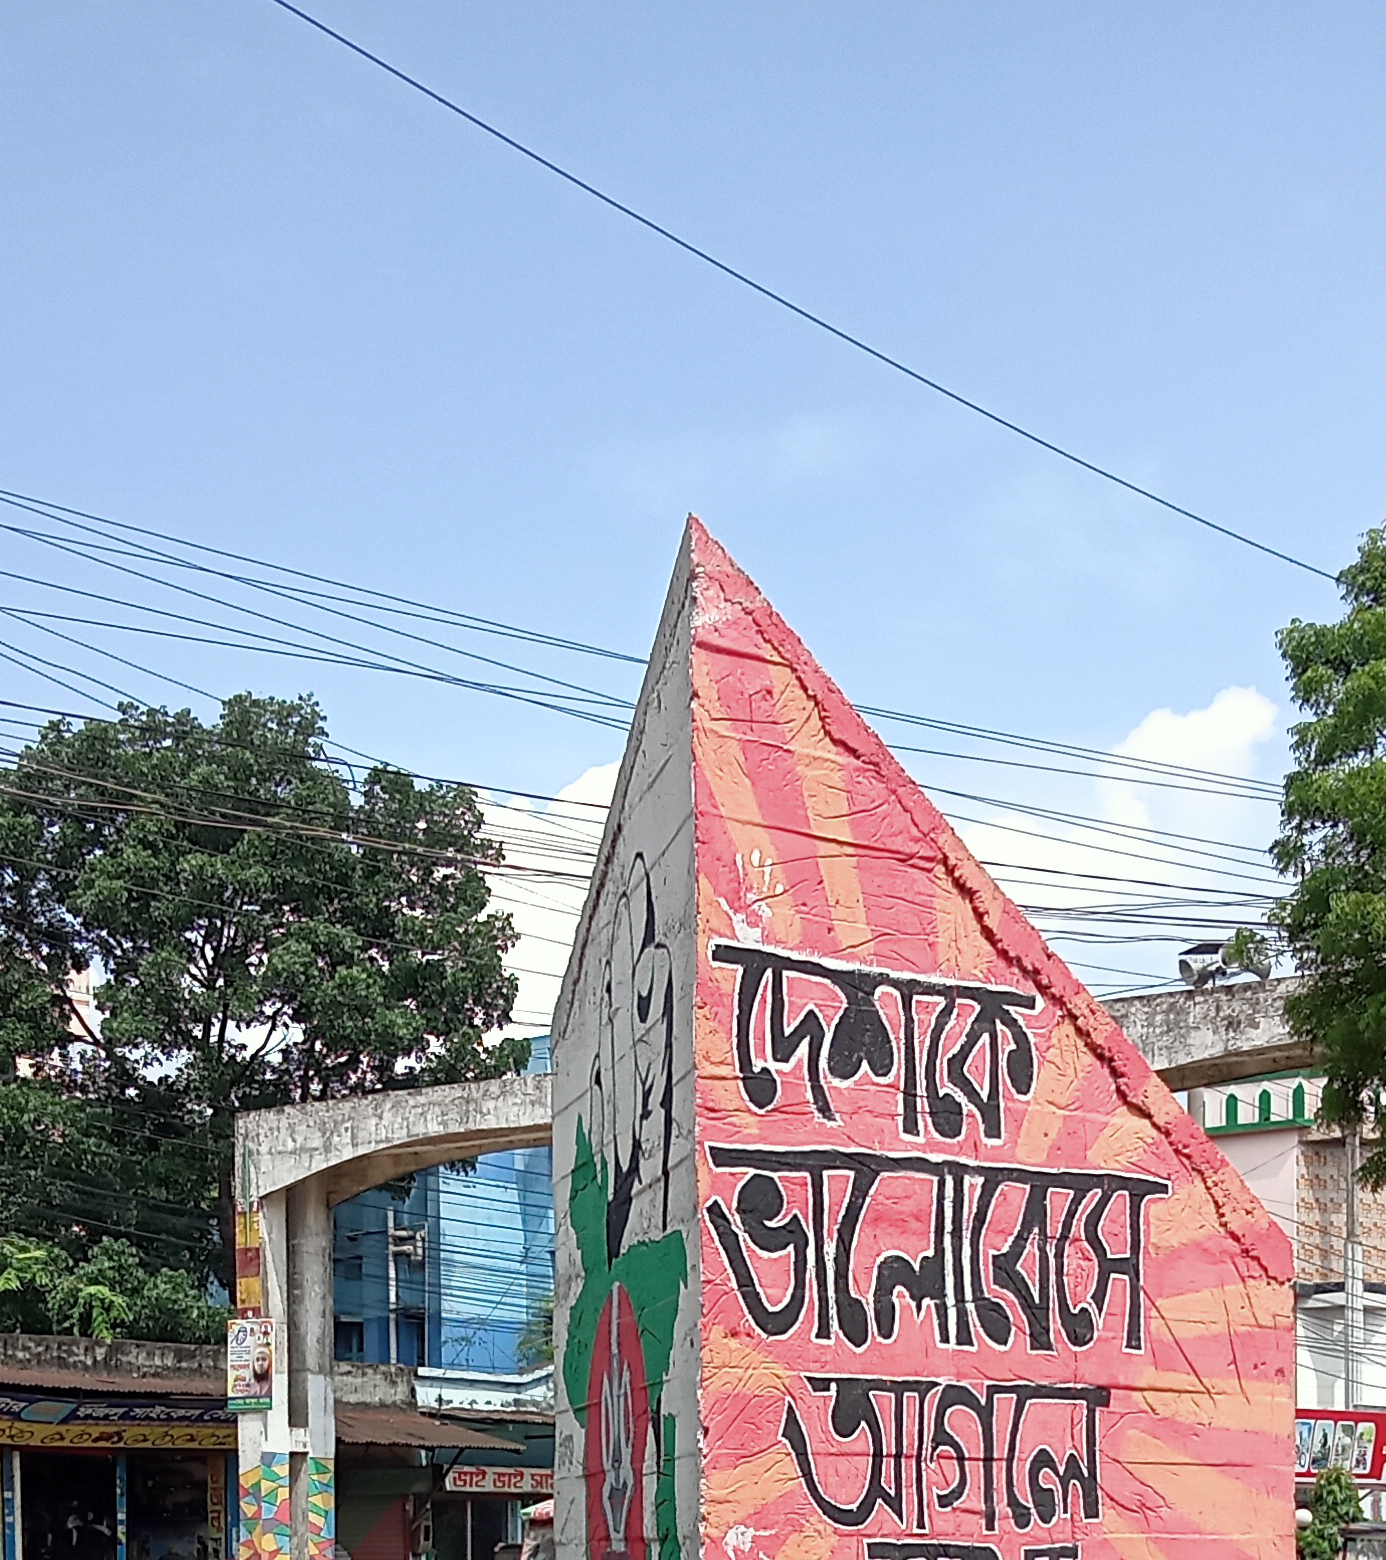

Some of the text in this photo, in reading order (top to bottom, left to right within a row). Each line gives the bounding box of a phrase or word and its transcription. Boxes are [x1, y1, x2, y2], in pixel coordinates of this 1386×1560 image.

[709, 938, 1038, 1144] দেশকে
[703, 1144, 1172, 1356] ভালোবেসে
[129, 1405, 205, 1420] সাইকেল
[452, 1466, 487, 1488] ভাই
[491, 1468, 525, 1489] ভাই
[780, 1374, 1112, 1538] আগলে
